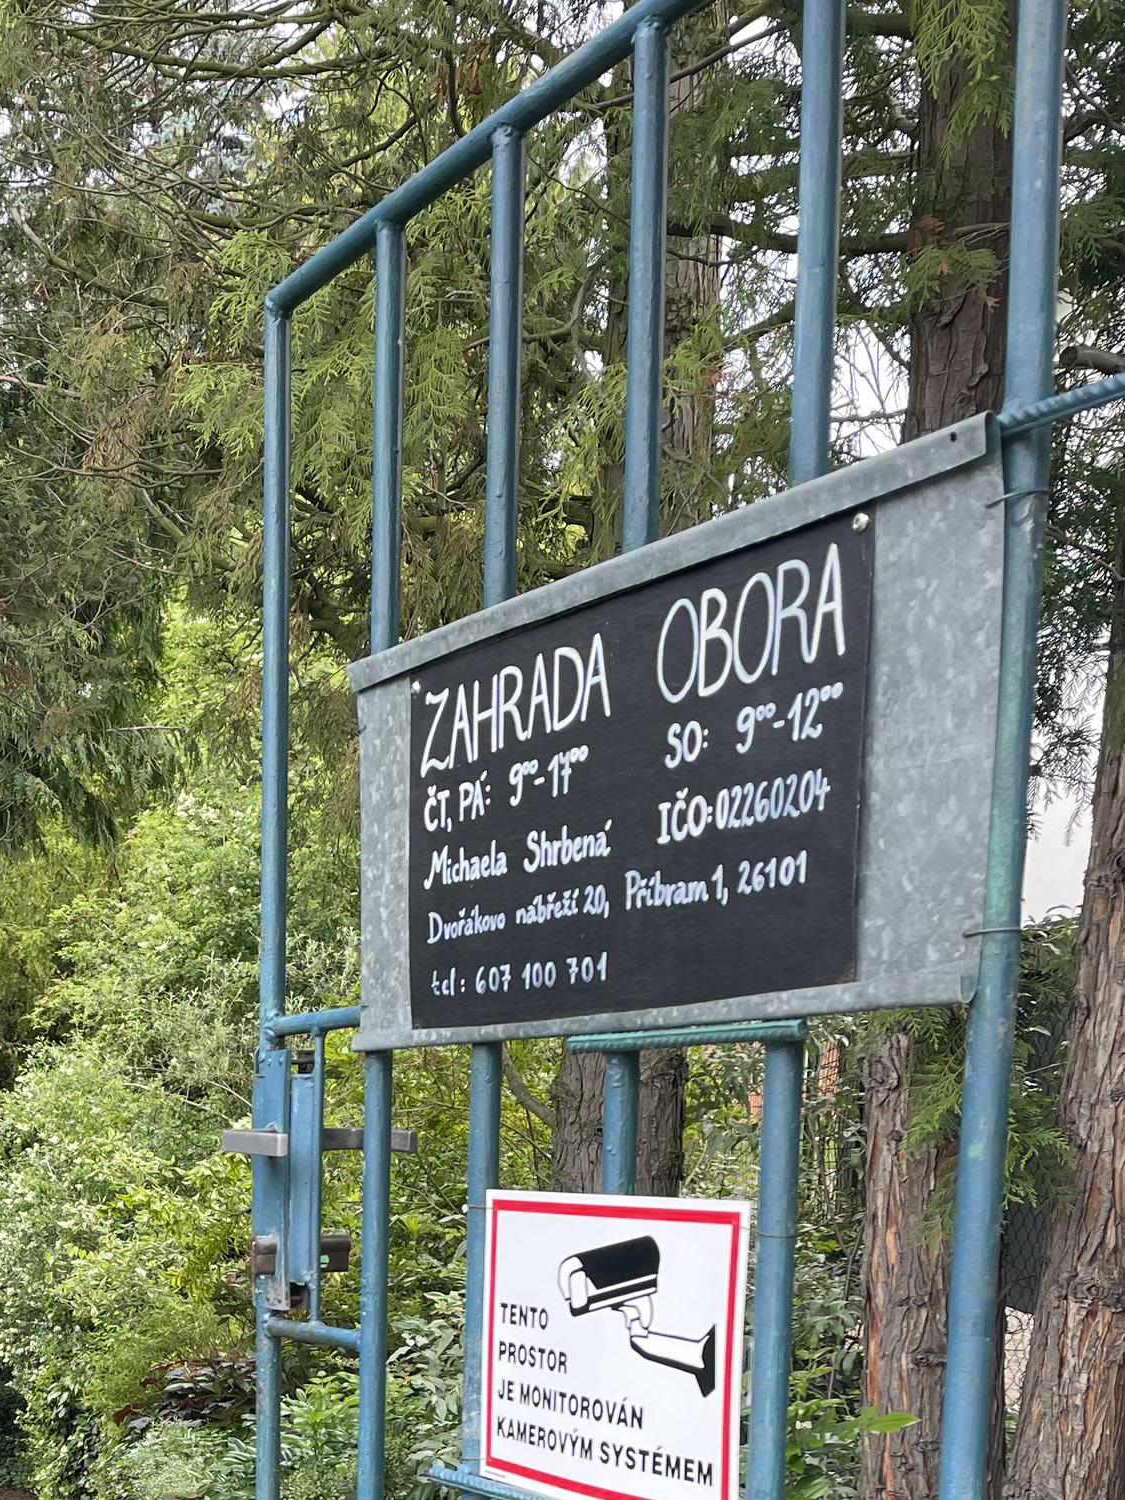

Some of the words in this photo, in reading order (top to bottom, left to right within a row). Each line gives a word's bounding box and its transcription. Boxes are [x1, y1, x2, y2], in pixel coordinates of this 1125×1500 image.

[420, 632, 612, 779] ZAHRADA
[656, 541, 846, 705] OBORA
[424, 784, 453, 833] ČT,
[458, 769, 492, 823] PÁ:
[664, 719, 709, 769] SO:
[423, 839, 508, 890] Michaela
[426, 904, 507, 945] Dvořákovo
[515, 887, 580, 925] nábřeží
[582, 883, 611, 920] 20,
[736, 849, 809, 895] 26101
[475, 963, 513, 995] 607
[521, 960, 558, 990] 100
[565, 950, 609, 985] 701
[499, 1302, 549, 1330] TENTO
[498, 1340, 569, 1375] PROSTOR
[497, 1378, 516, 1402] JE
[519, 1382, 645, 1430] MONITOROVÁN
[496, 1415, 594, 1461] KAMEROVÝM
[599, 1440, 715, 1487] SYSTÉMEM
